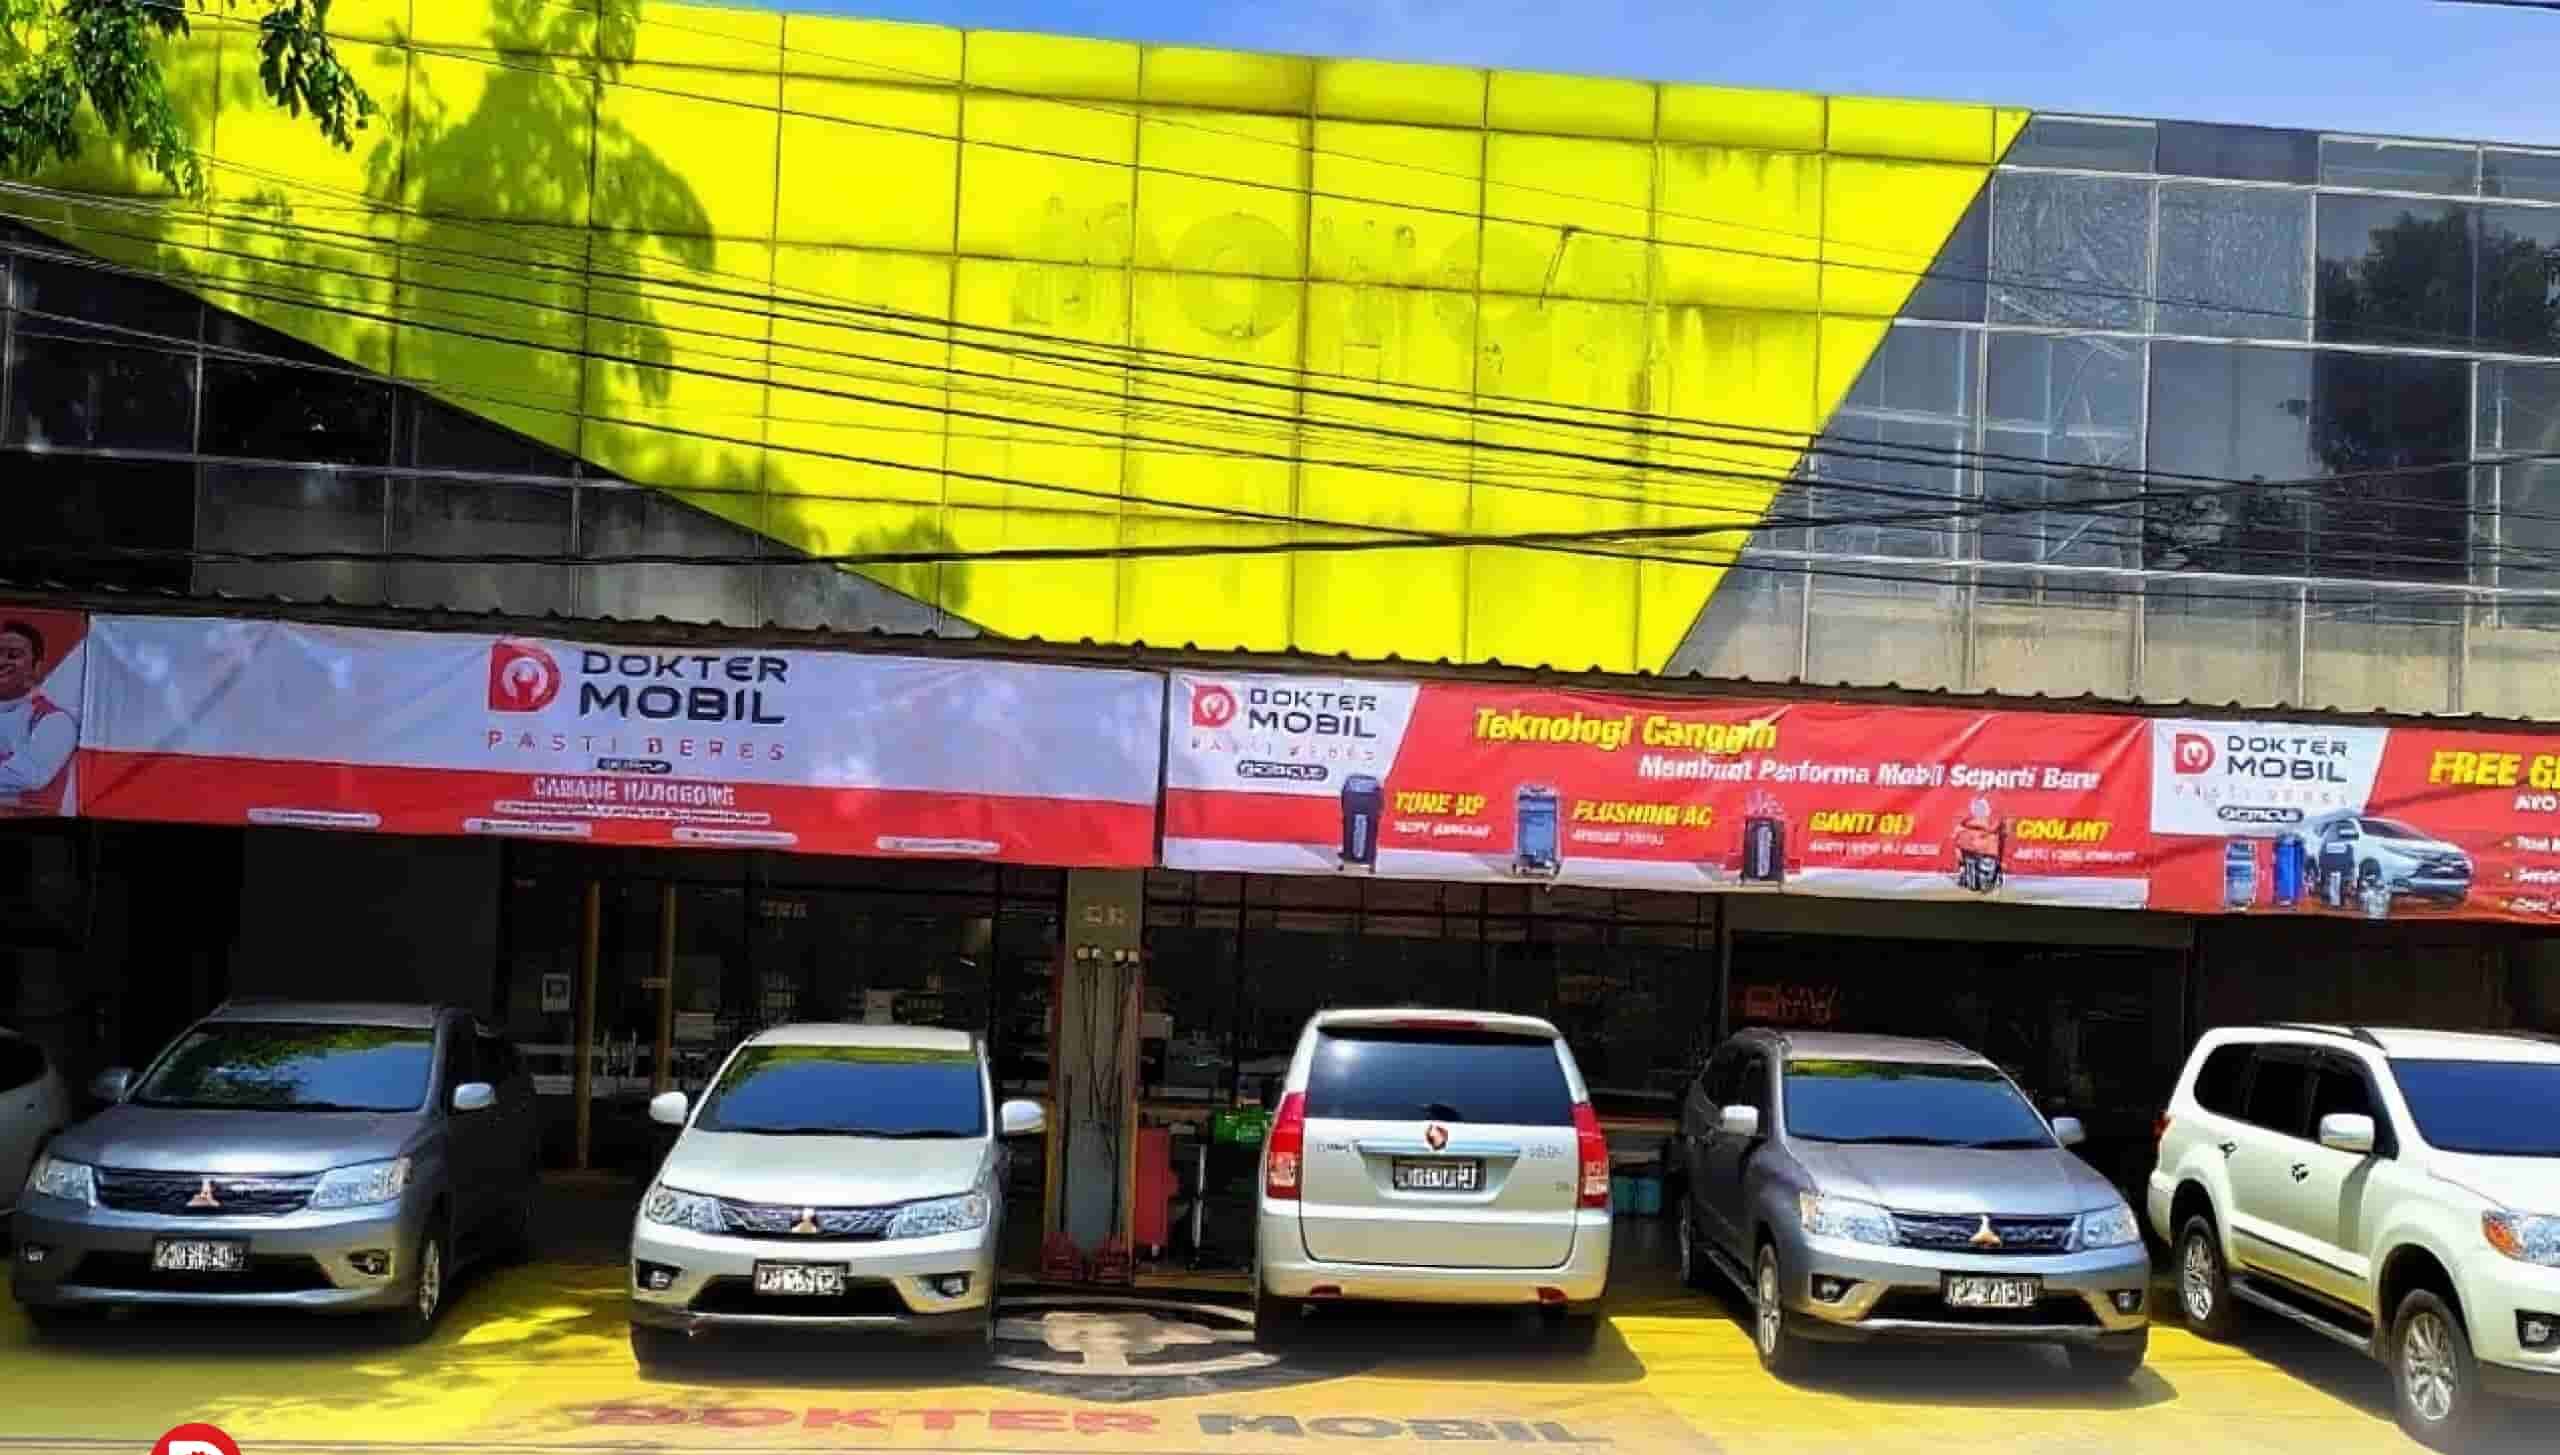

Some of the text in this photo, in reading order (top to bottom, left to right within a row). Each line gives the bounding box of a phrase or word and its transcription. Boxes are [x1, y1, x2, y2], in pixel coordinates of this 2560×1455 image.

[582, 652, 788, 683] DOKTER
[580, 683, 785, 724] MOBIL
[1249, 688, 1376, 711] DOKTER
[1249, 711, 1377, 738] MOBIL
[1475, 708, 1632, 750] Teknologi
[488, 730, 785, 761] PASTI BERES
[2226, 735, 2348, 757] DOKTER
[1637, 754, 1754, 780] Membuat
[1876, 763, 1945, 785] Mobil
[2041, 768, 2100, 789] Baru
[2227, 757, 2347, 783] MOBIL
[2428, 749, 2522, 787] FREE
[1681, 805, 1713, 825] AC
[2016, 818, 2112, 841] COOLANT
[589, 1407, 1612, 1444] DOKTER MOBIL
